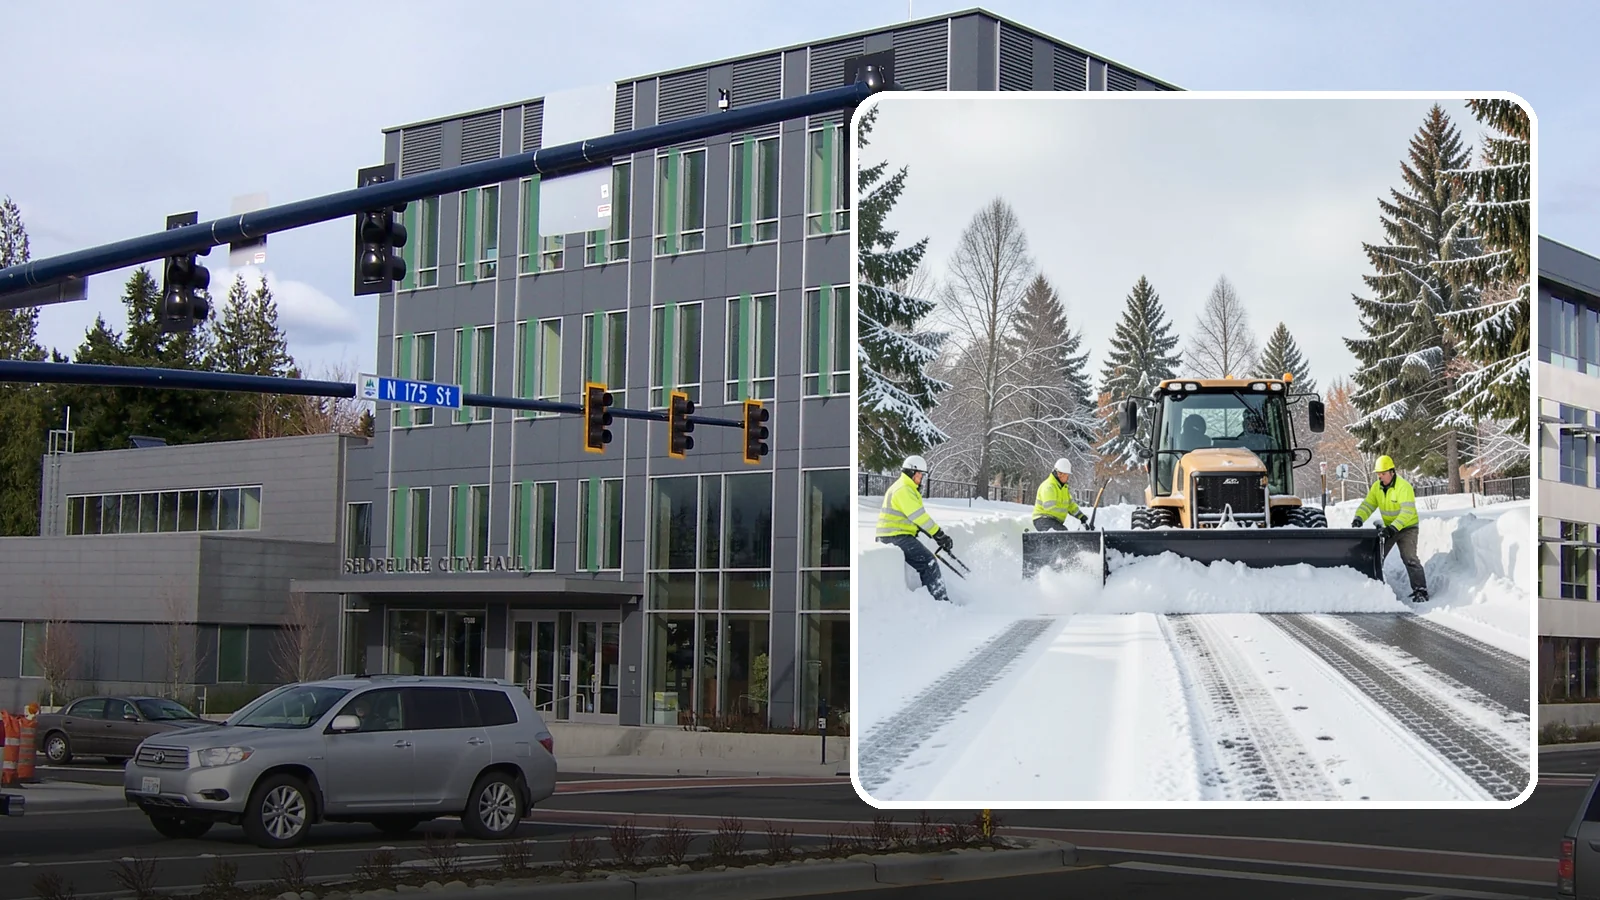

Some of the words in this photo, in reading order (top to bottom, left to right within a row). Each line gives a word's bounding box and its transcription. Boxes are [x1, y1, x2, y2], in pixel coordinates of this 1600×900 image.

[387, 381, 396, 400] N
[405, 383, 427, 403] 175
[436, 387, 451, 406] St
[344, 556, 432, 574] SHORELINE
[439, 556, 476, 573] CITY
[484, 556, 525, 573] HALL
